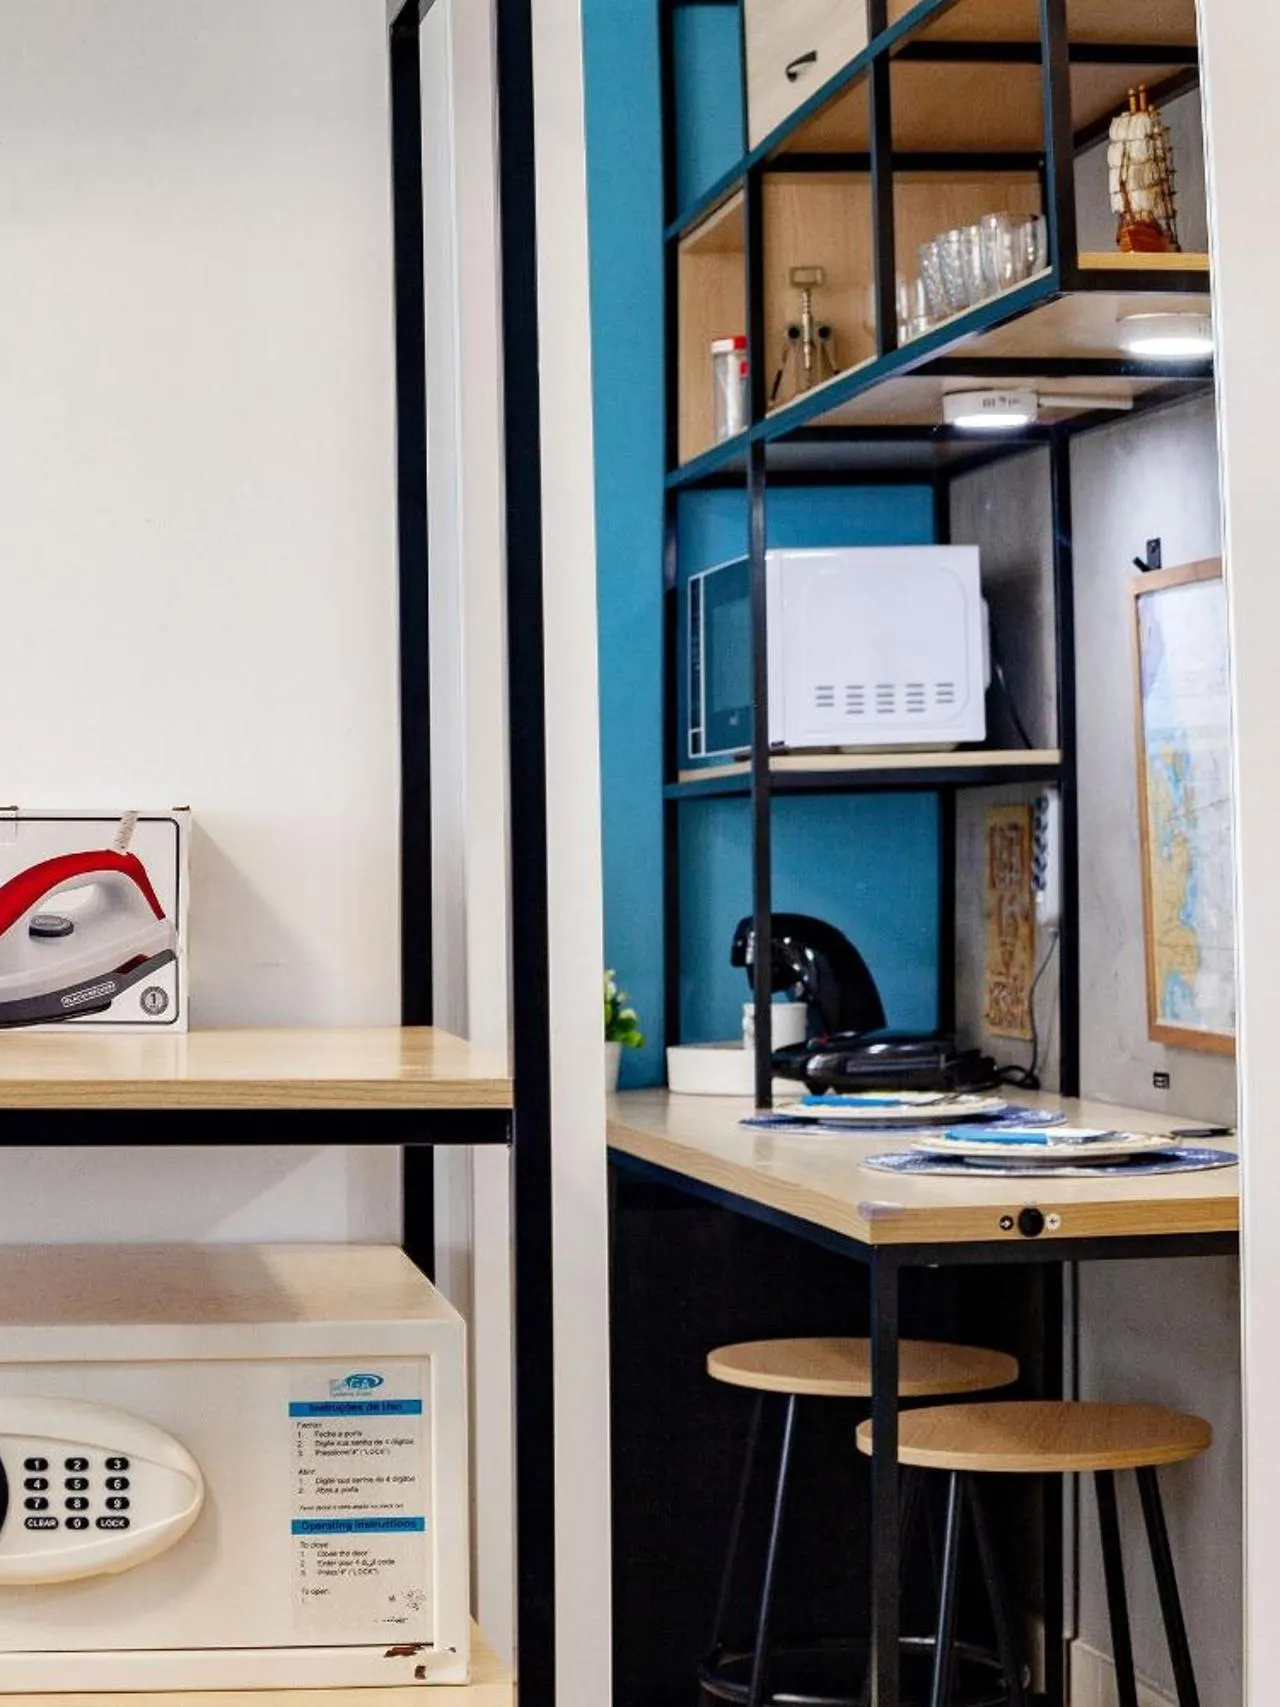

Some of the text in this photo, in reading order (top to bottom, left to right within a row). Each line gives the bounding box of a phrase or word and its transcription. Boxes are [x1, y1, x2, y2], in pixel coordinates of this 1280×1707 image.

[34, 1460, 40, 1469] 1
[73, 1460, 81, 1470] 2
[113, 1460, 121, 1469] 3
[33, 1480, 41, 1489] 4
[73, 1480, 81, 1489] 5
[113, 1480, 121, 1489] 6
[33, 1499, 41, 1508] 7
[73, 1499, 81, 1508] 8
[113, 1499, 121, 1508] 9
[27, 1519, 57, 1527] CLEAR
[73, 1519, 81, 1528] 0
[100, 1519, 125, 1527] LOCK
